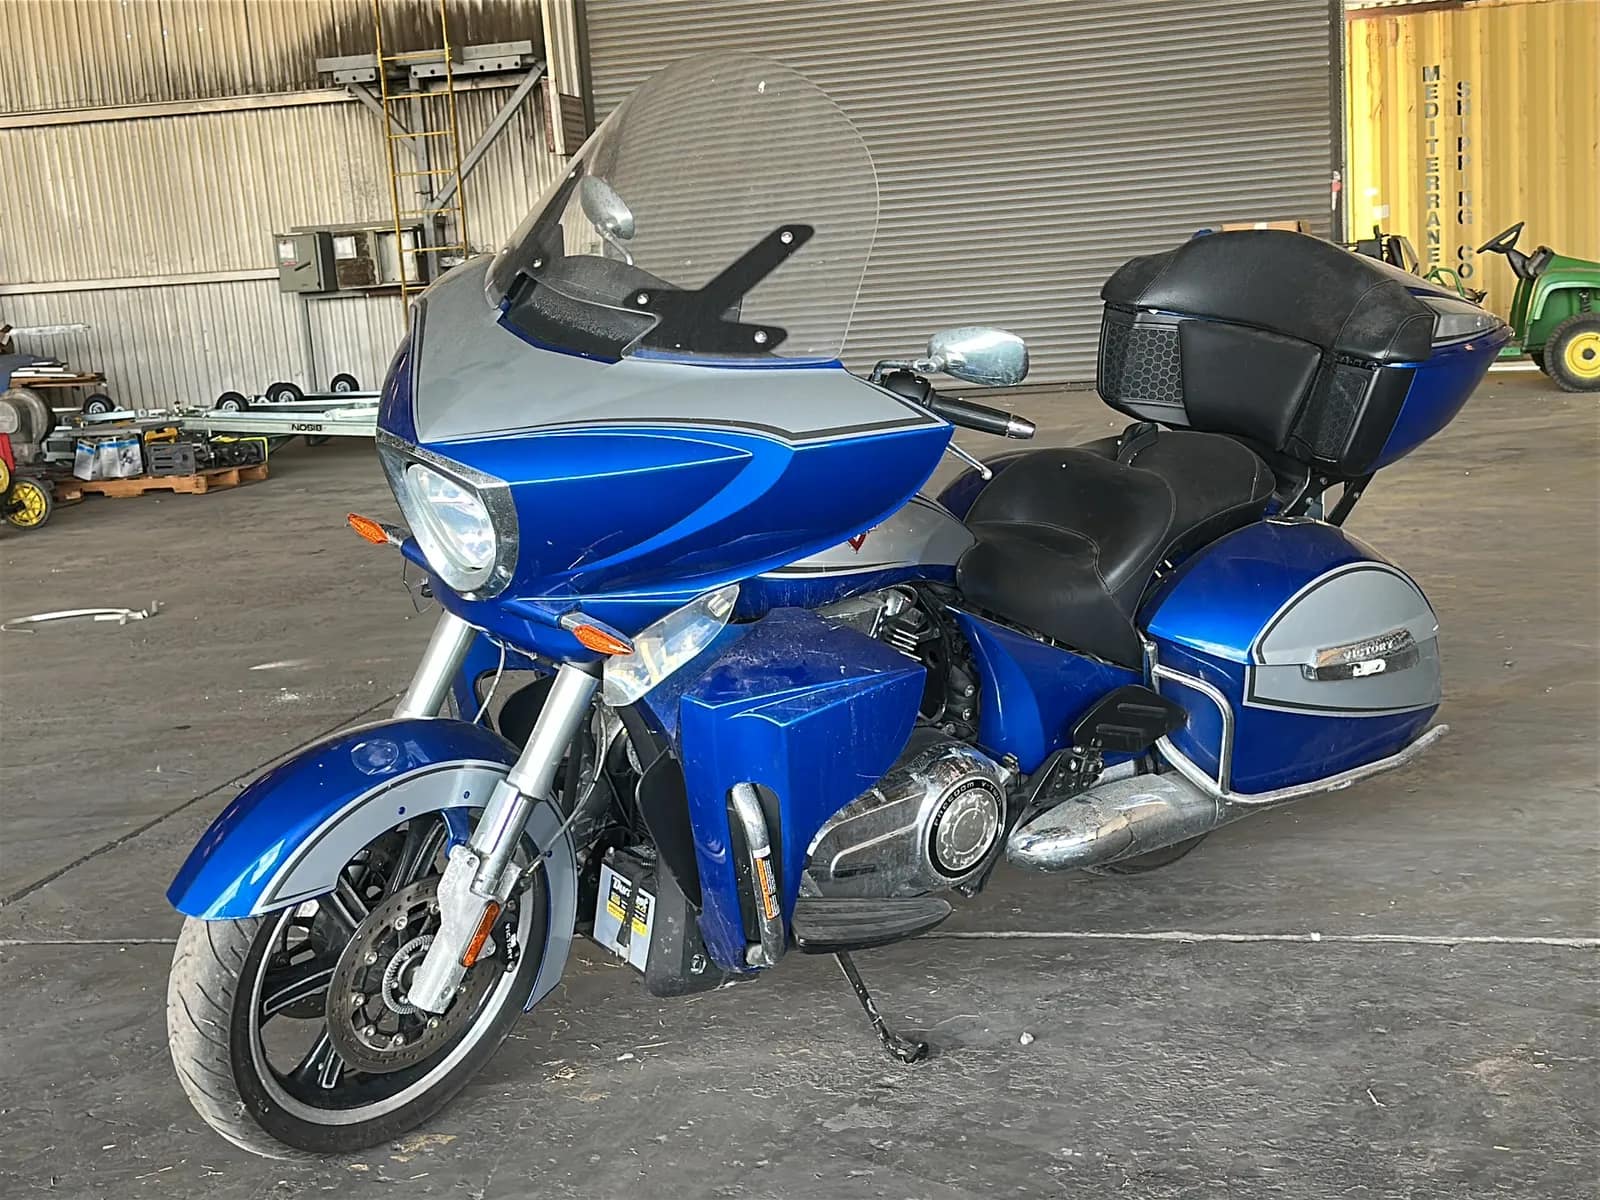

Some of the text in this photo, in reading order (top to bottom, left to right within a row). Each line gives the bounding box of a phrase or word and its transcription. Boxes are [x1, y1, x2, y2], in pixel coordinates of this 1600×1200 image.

[1456, 80, 1473, 278] SHIPPING CO
[1343, 639, 1394, 660] VICTORY
[505, 922, 513, 960] VICTORY
